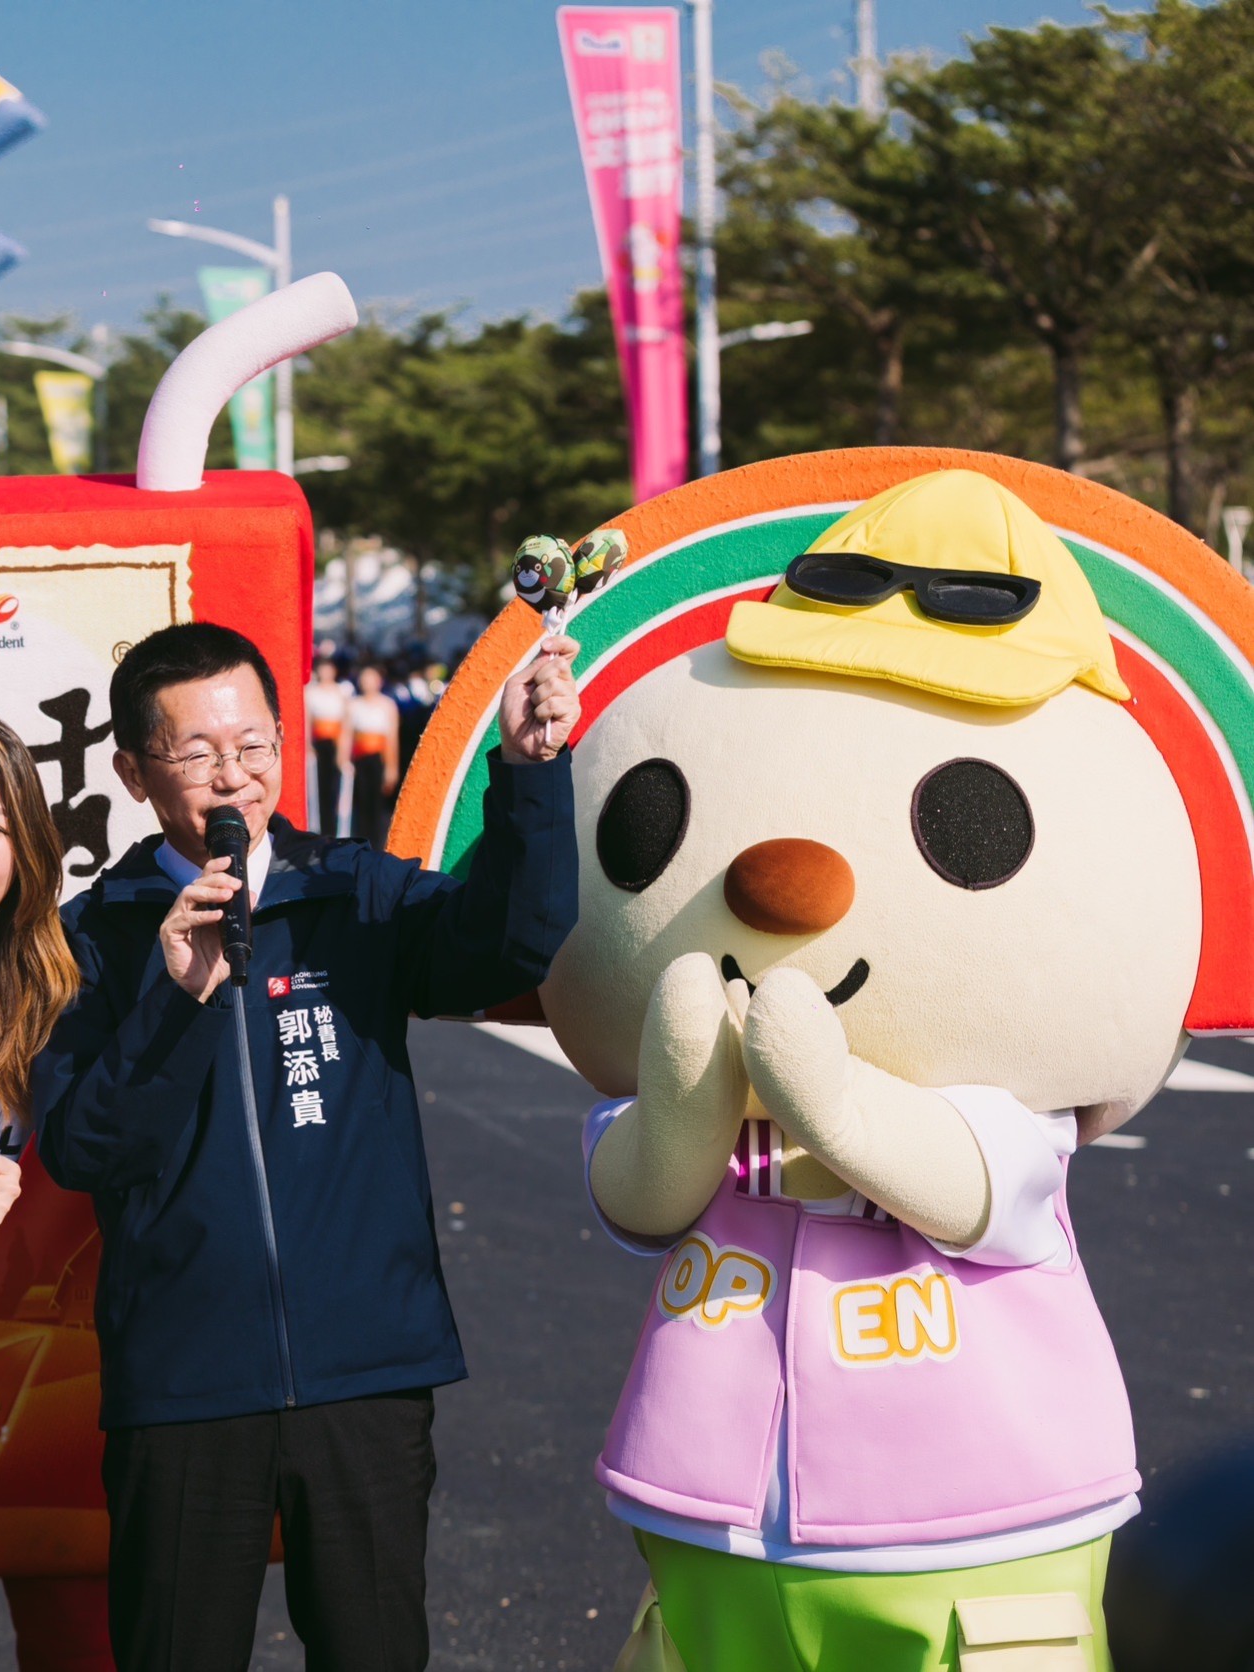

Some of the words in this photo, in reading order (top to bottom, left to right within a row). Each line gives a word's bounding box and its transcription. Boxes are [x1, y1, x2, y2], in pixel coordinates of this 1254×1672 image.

[291, 981, 330, 990] GOVERNMENT
[276, 1008, 327, 1128] 郭添貴
[312, 1005, 340, 1062] 秘書長
[660, 1234, 774, 1327] OP
[830, 1270, 959, 1364] EN
